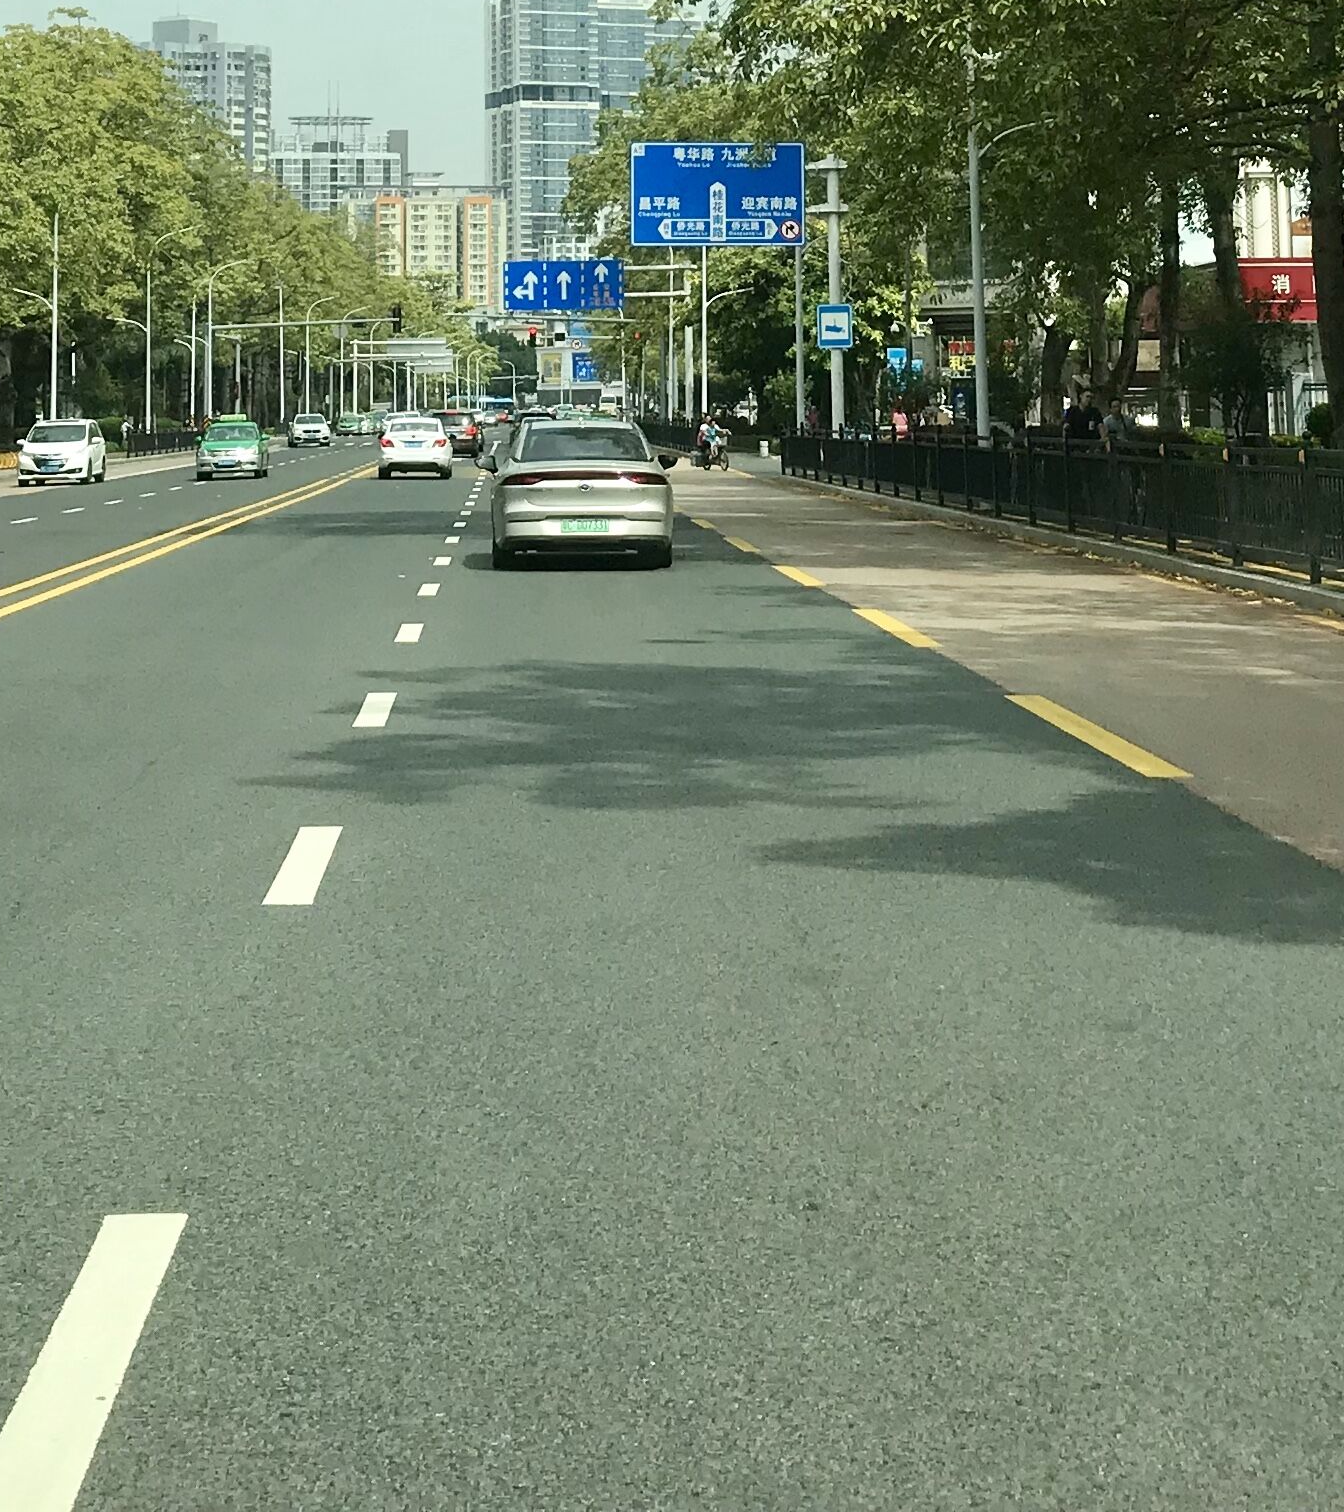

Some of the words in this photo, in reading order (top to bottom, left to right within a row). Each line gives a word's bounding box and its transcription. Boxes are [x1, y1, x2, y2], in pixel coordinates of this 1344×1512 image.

[673, 147, 715, 162] 粤华路
[639, 196, 680, 210] 昌平路
[741, 196, 798, 210] 迎宾南路
